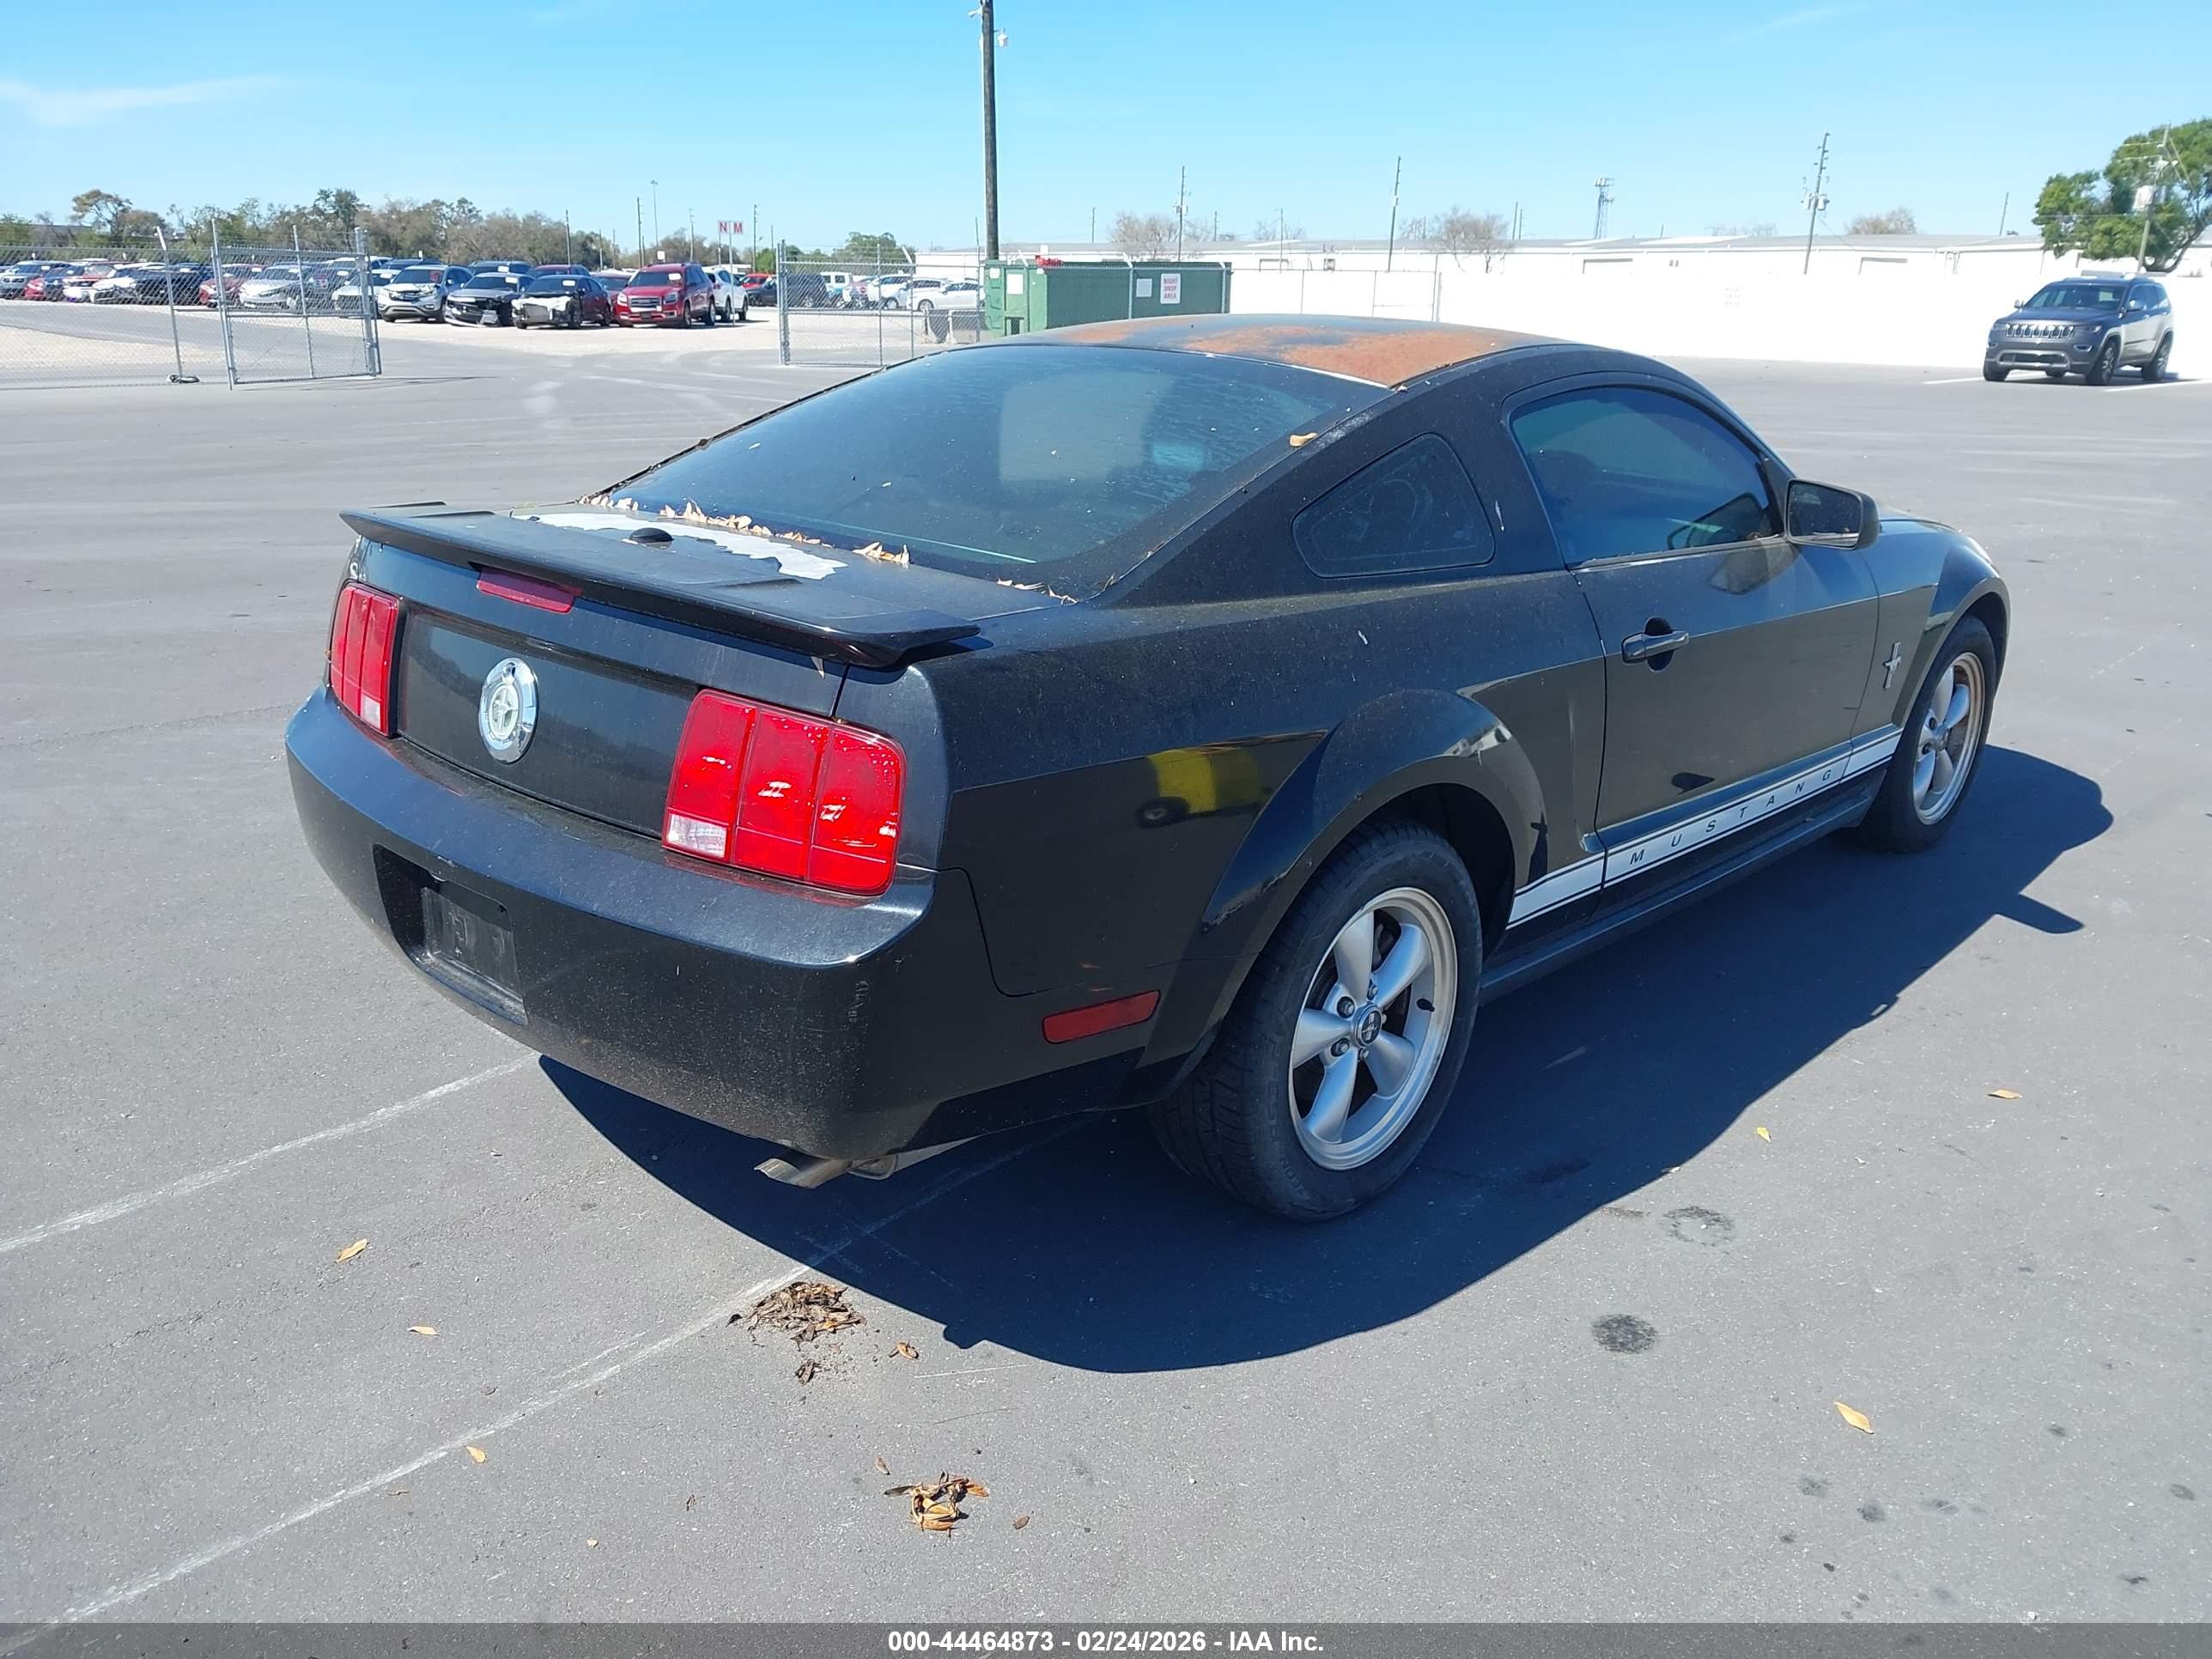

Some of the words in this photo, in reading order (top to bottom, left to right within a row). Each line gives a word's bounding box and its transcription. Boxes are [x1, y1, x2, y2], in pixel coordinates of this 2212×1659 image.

[720, 222, 727, 232] N
[733, 222, 743, 234] M
[1630, 769, 1832, 865] MUSTANG
